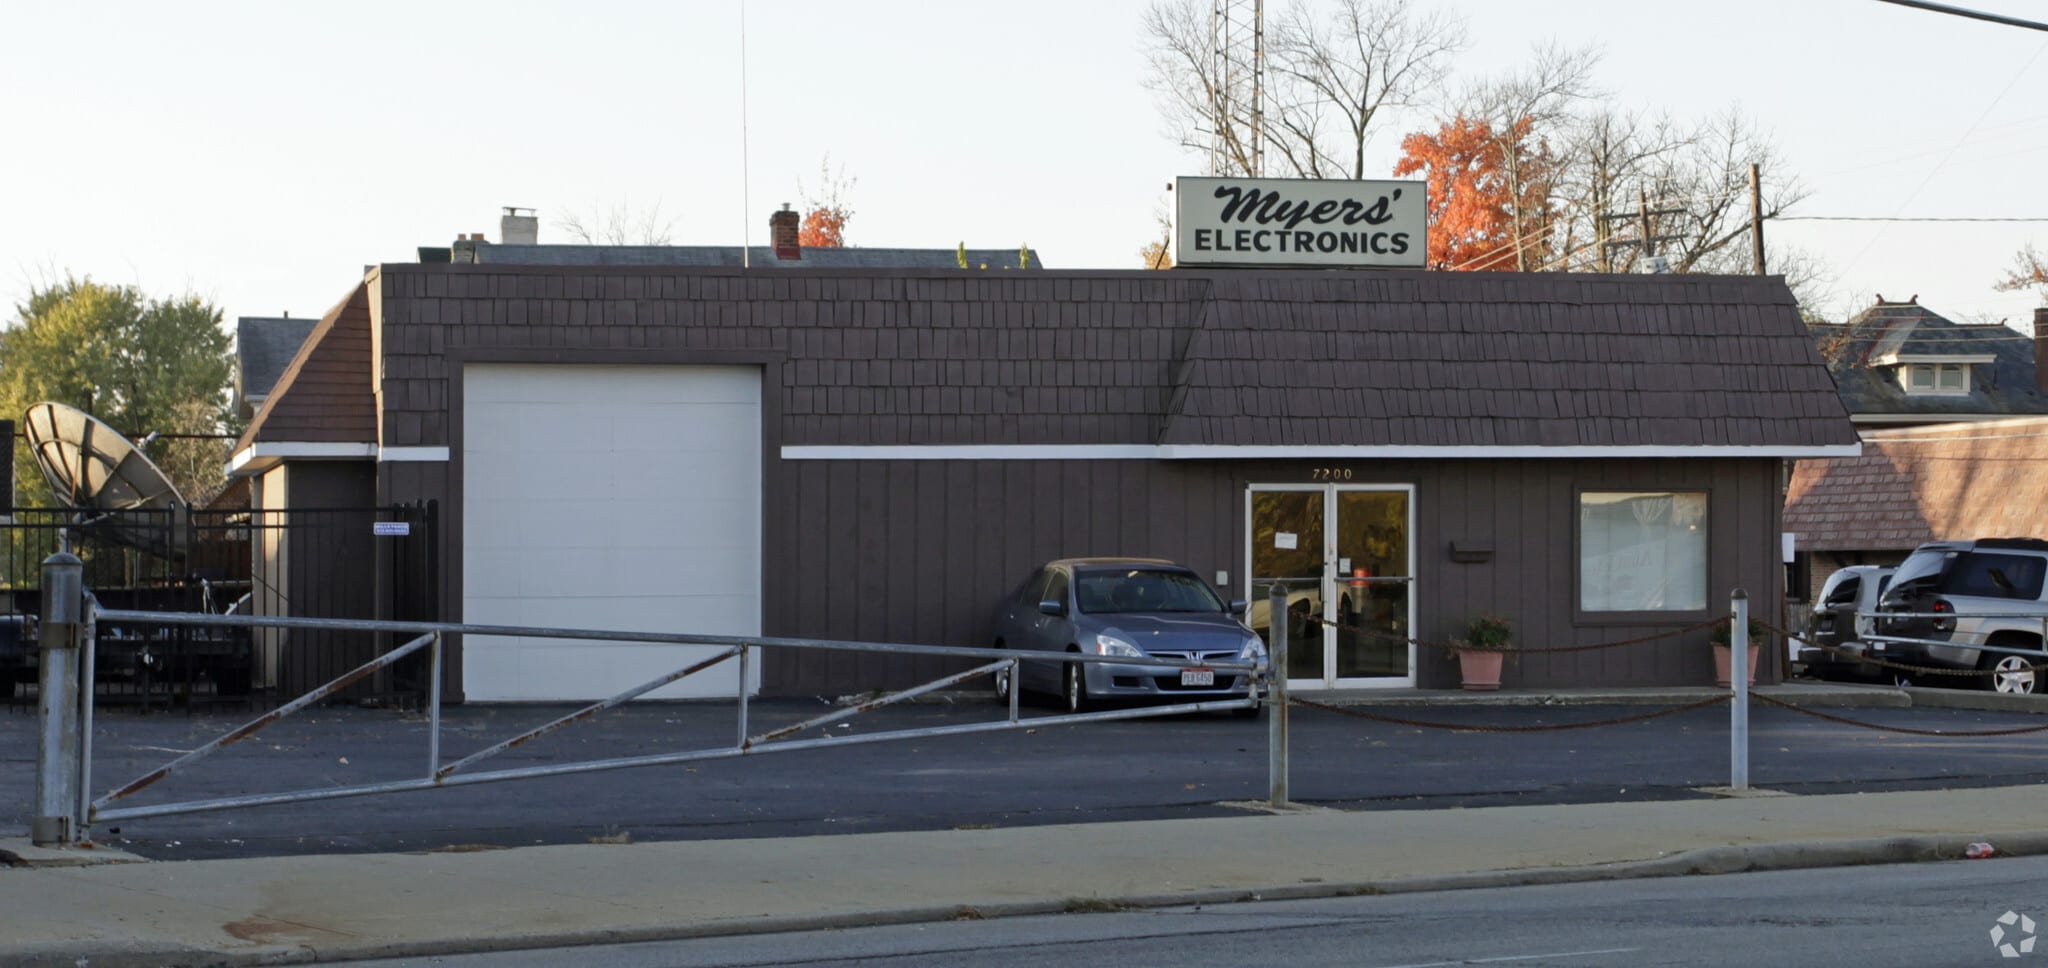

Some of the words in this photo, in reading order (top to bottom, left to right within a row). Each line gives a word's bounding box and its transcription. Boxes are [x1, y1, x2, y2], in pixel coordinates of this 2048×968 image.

[1214, 185, 1402, 230] Myers'
[1195, 229, 1410, 255] ELECTRONICS
[1313, 468, 1352, 480] 7200
